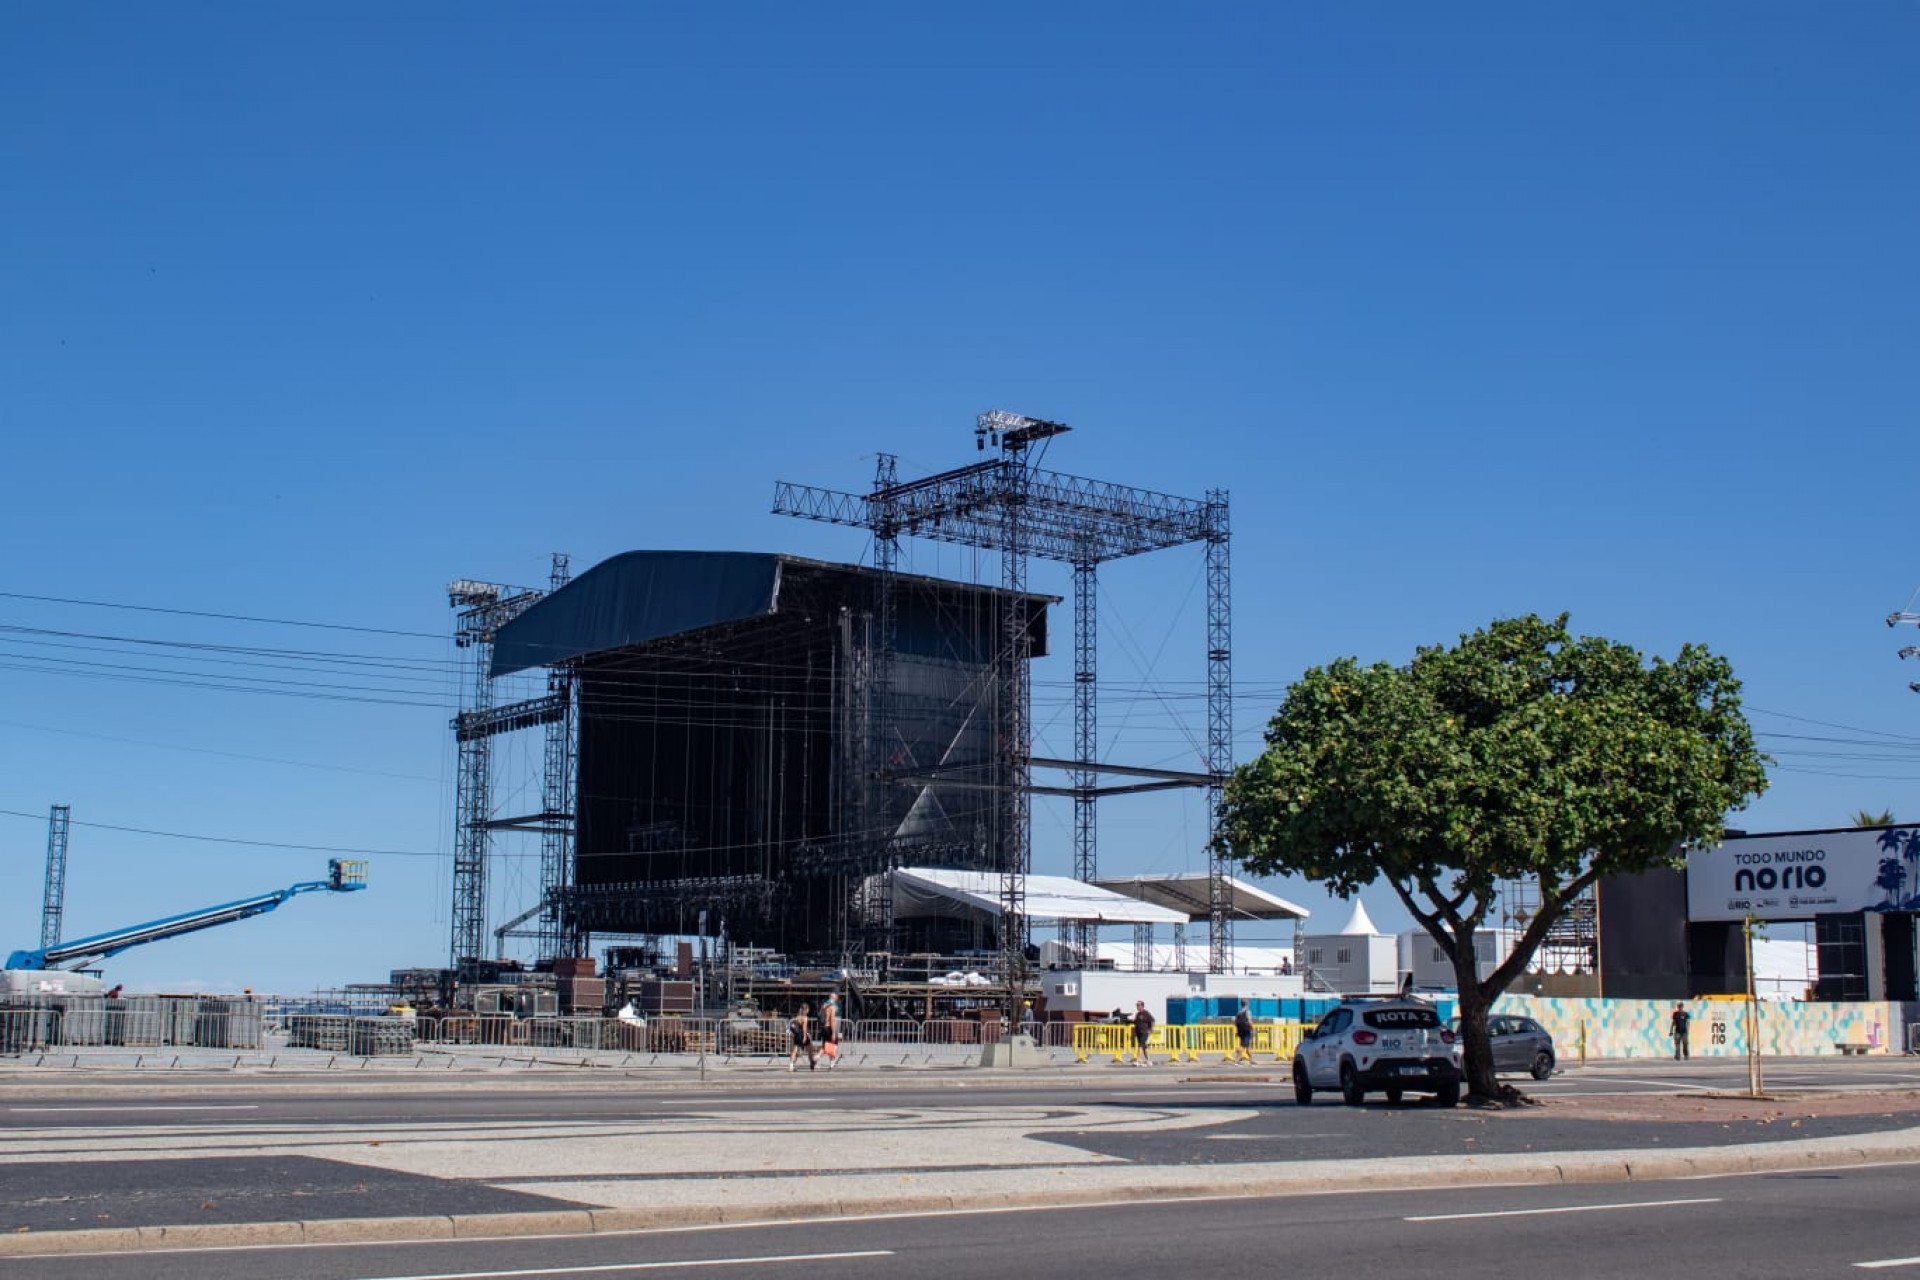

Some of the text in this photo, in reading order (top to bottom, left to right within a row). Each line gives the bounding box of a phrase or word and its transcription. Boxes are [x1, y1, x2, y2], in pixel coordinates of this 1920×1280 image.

[1735, 850, 1826, 864] TODO MUNDO
[1376, 1012, 1432, 1023] ROTA 2
[1382, 1039, 1401, 1048] RIO
